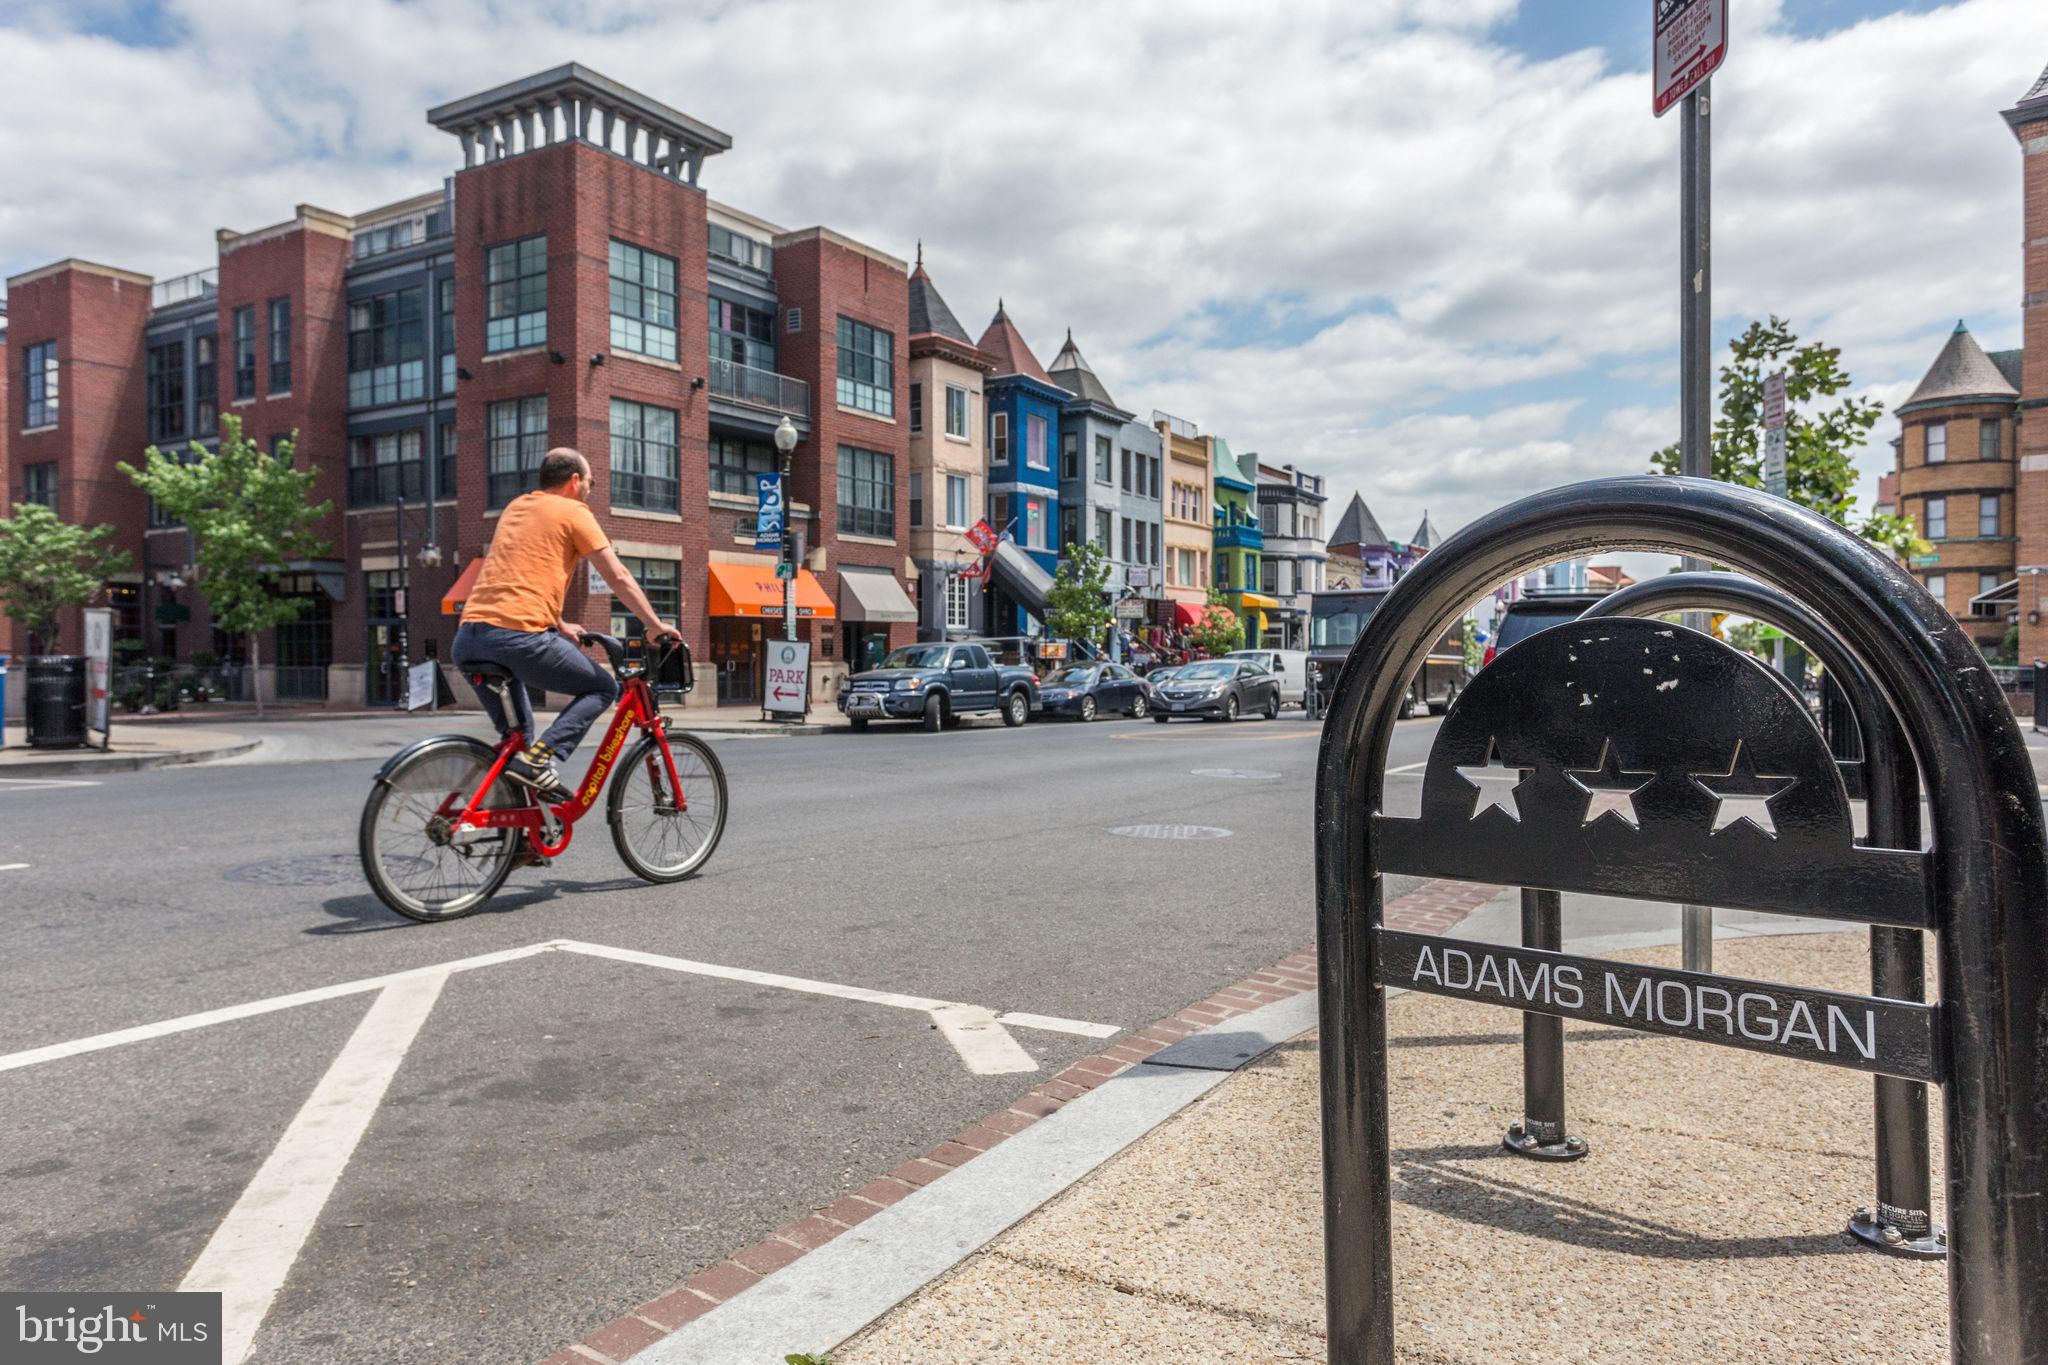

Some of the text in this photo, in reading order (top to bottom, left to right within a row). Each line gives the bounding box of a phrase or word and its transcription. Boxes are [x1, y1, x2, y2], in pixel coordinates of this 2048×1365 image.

[769, 668, 805, 684] PARK
[581, 709, 636, 806] capital bikeshare
[1412, 945, 1876, 1060] ADAMS MORGAN
